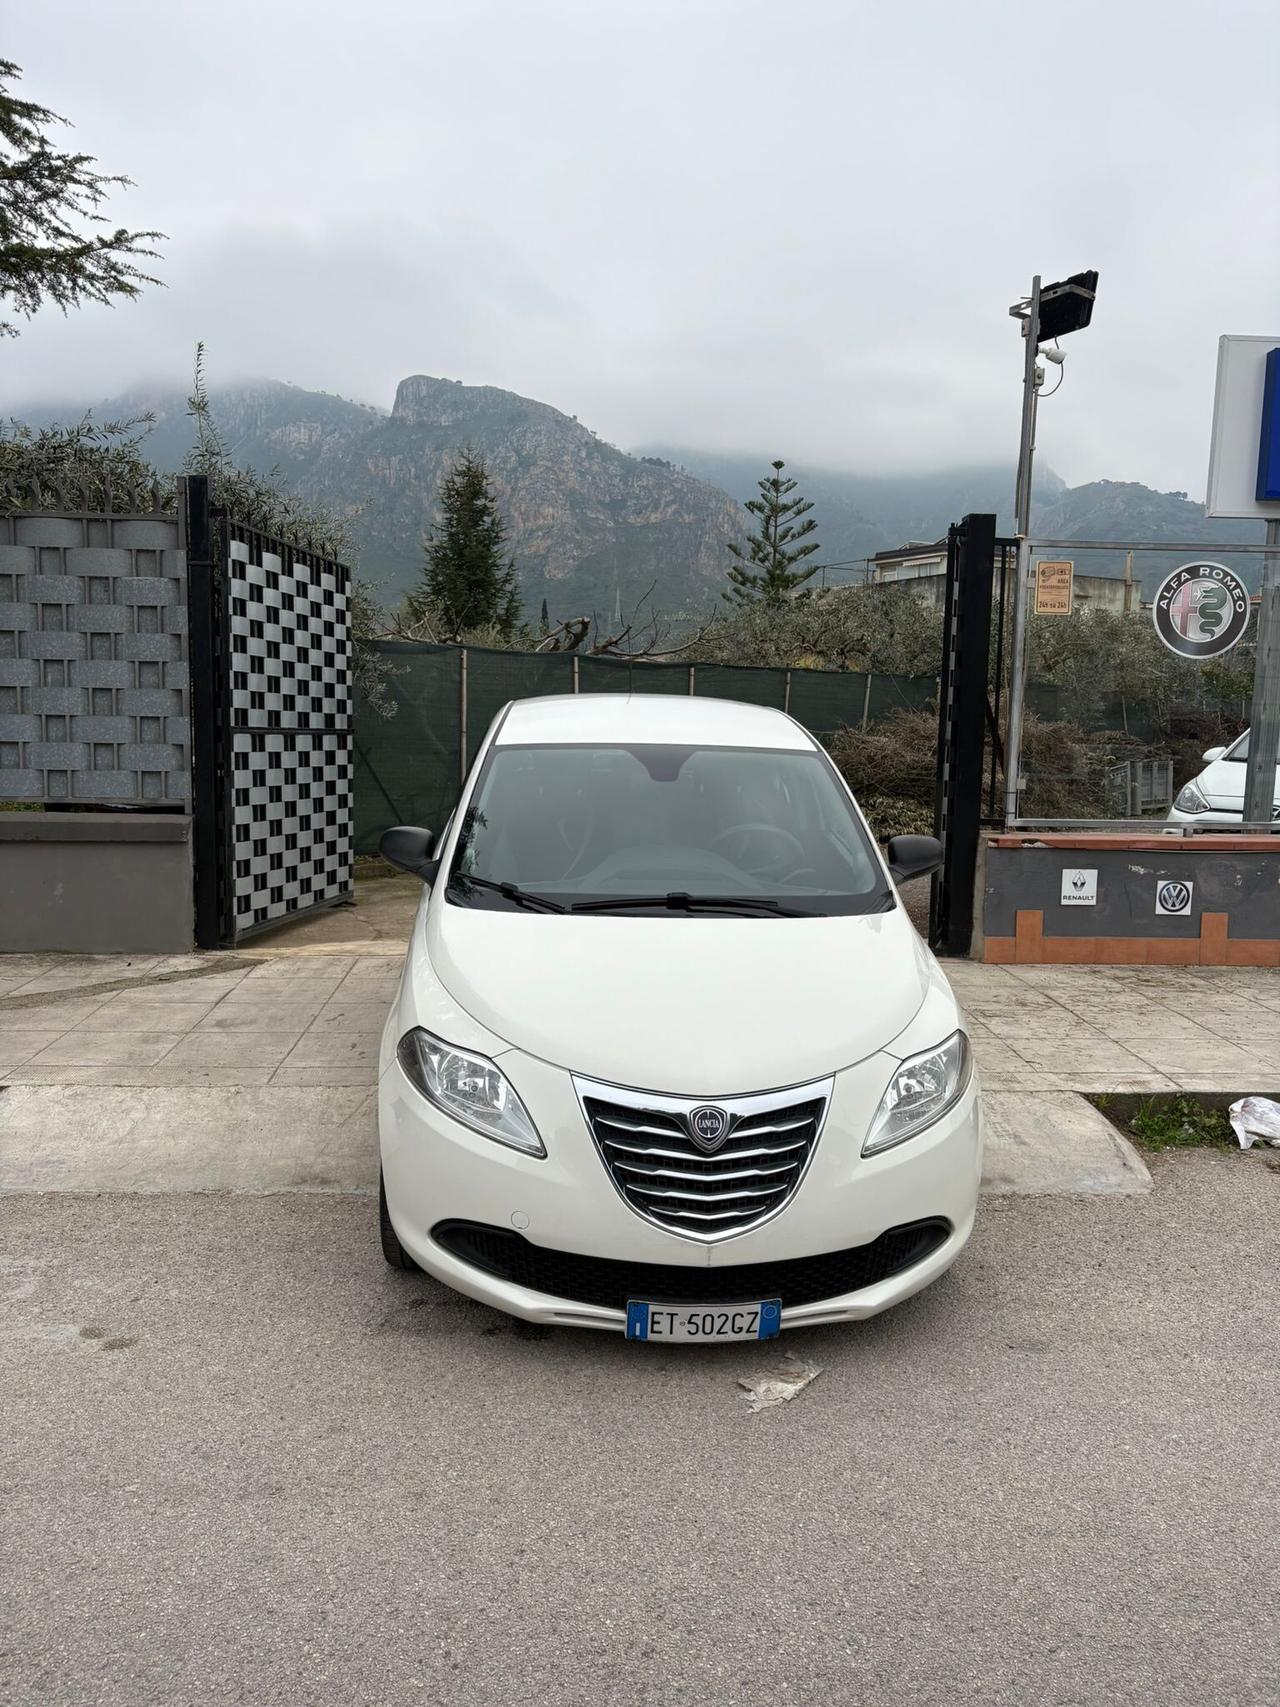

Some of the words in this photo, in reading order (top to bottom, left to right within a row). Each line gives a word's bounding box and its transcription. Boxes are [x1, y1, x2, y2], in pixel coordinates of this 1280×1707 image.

[1160, 572, 1191, 610] ALFA
[1200, 567, 1245, 612] ROMEO
[699, 1119, 720, 1128] LANCIA
[650, 1312, 678, 1335] ET
[687, 1311, 759, 1335] 502GZ
